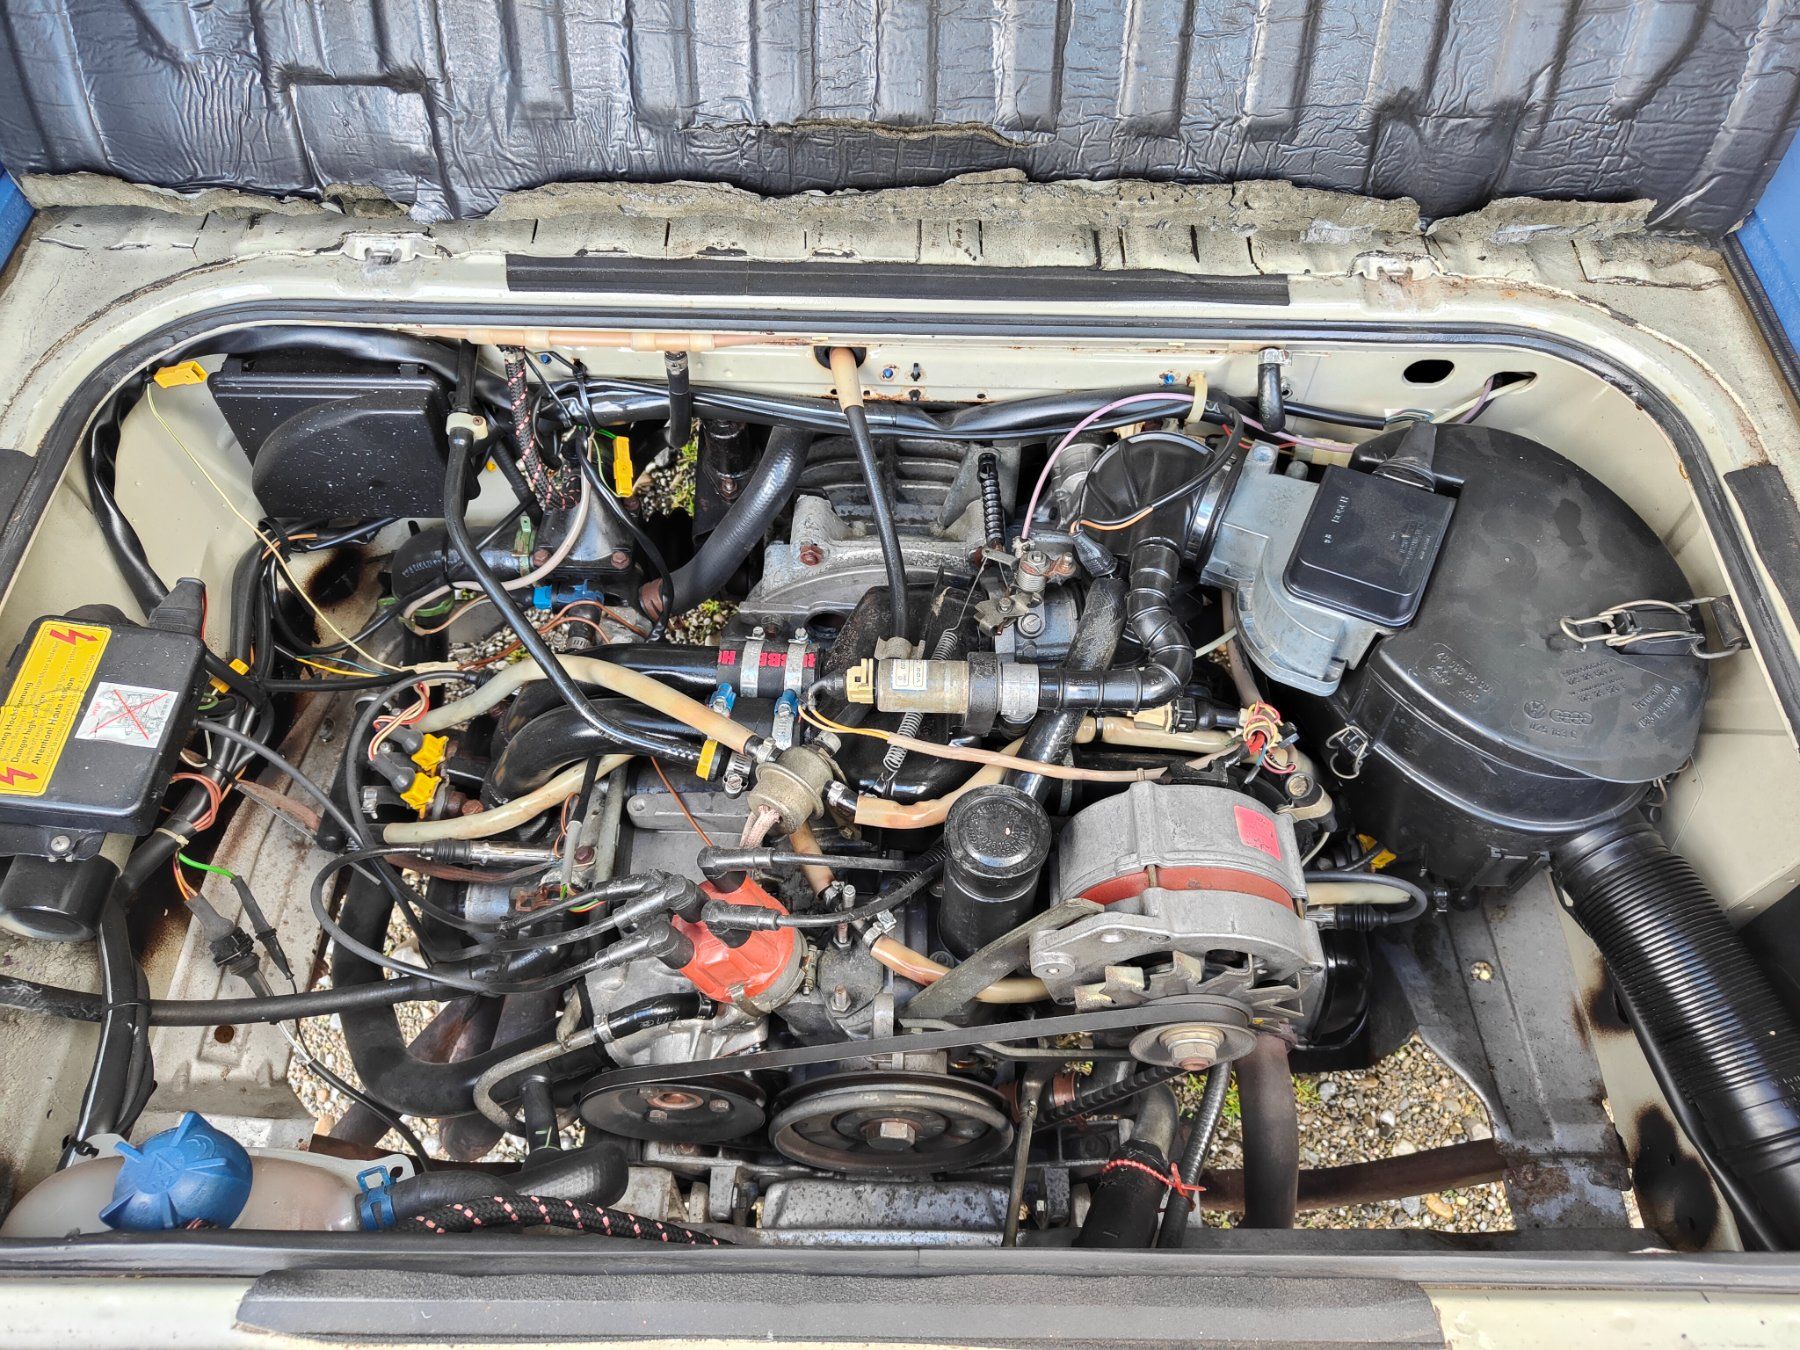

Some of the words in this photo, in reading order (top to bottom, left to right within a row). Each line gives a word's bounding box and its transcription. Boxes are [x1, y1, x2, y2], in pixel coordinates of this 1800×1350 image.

[11, 737, 28, 763] Danger
[25, 721, 37, 737] high
[32, 727, 53, 764] Attention!
